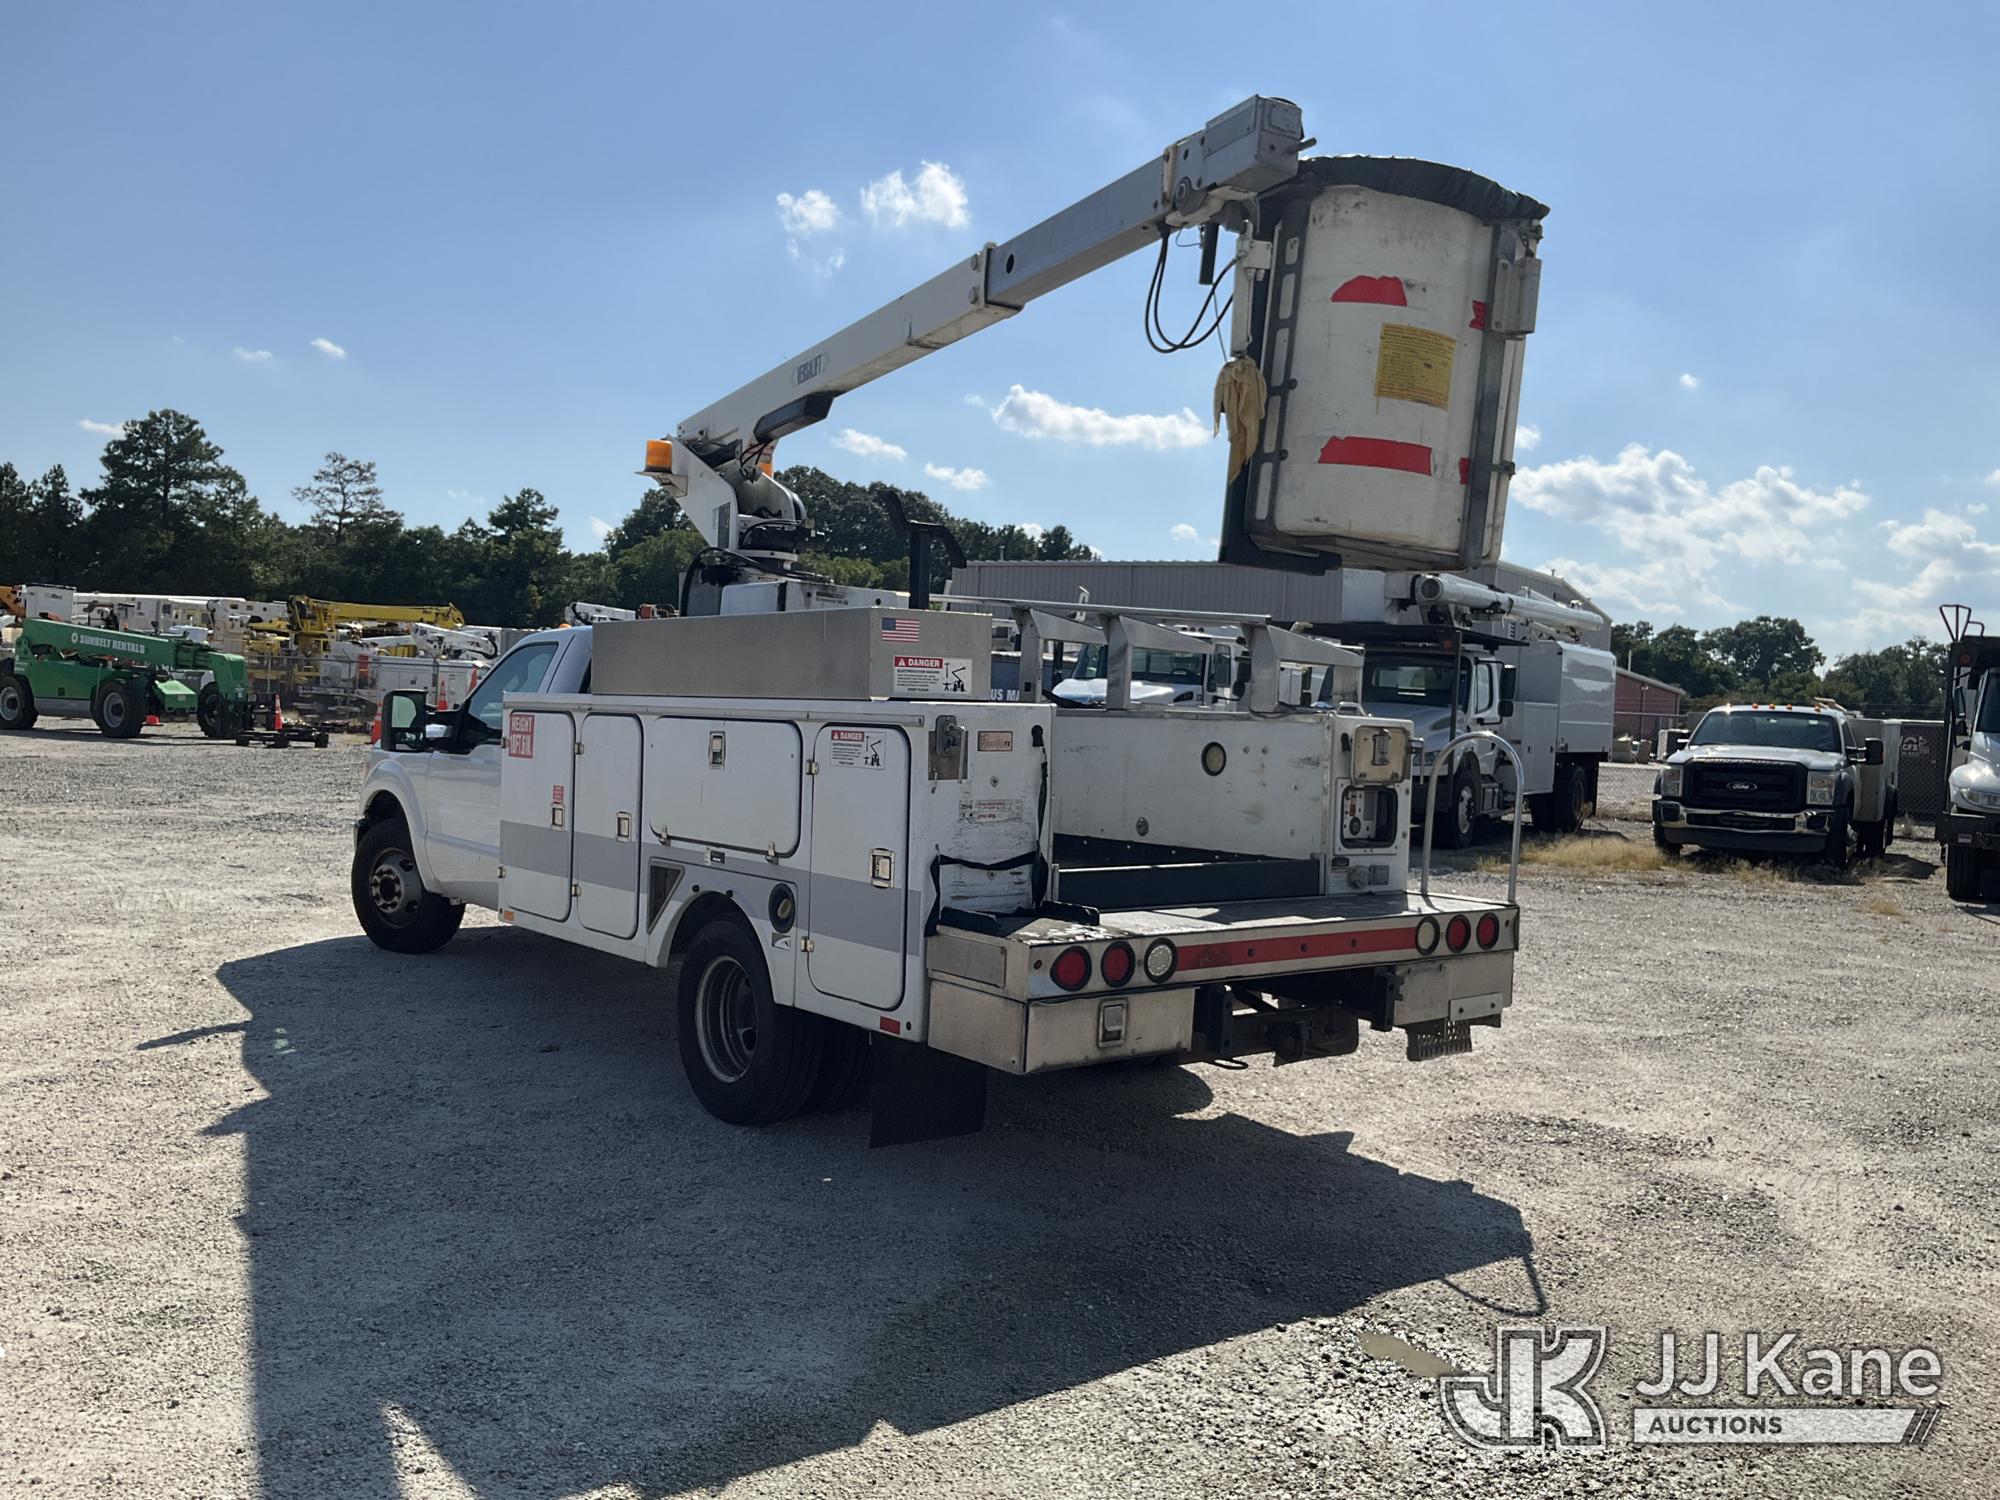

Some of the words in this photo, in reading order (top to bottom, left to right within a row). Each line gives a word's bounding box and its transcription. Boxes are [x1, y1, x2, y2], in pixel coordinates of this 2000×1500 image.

[80, 634, 111, 648] SUNBELT
[112, 639, 145, 654] RENTALS
[908, 658, 940, 668] DANGER
[512, 716, 533, 732] HEIGHT
[840, 731, 863, 741] DANGER
